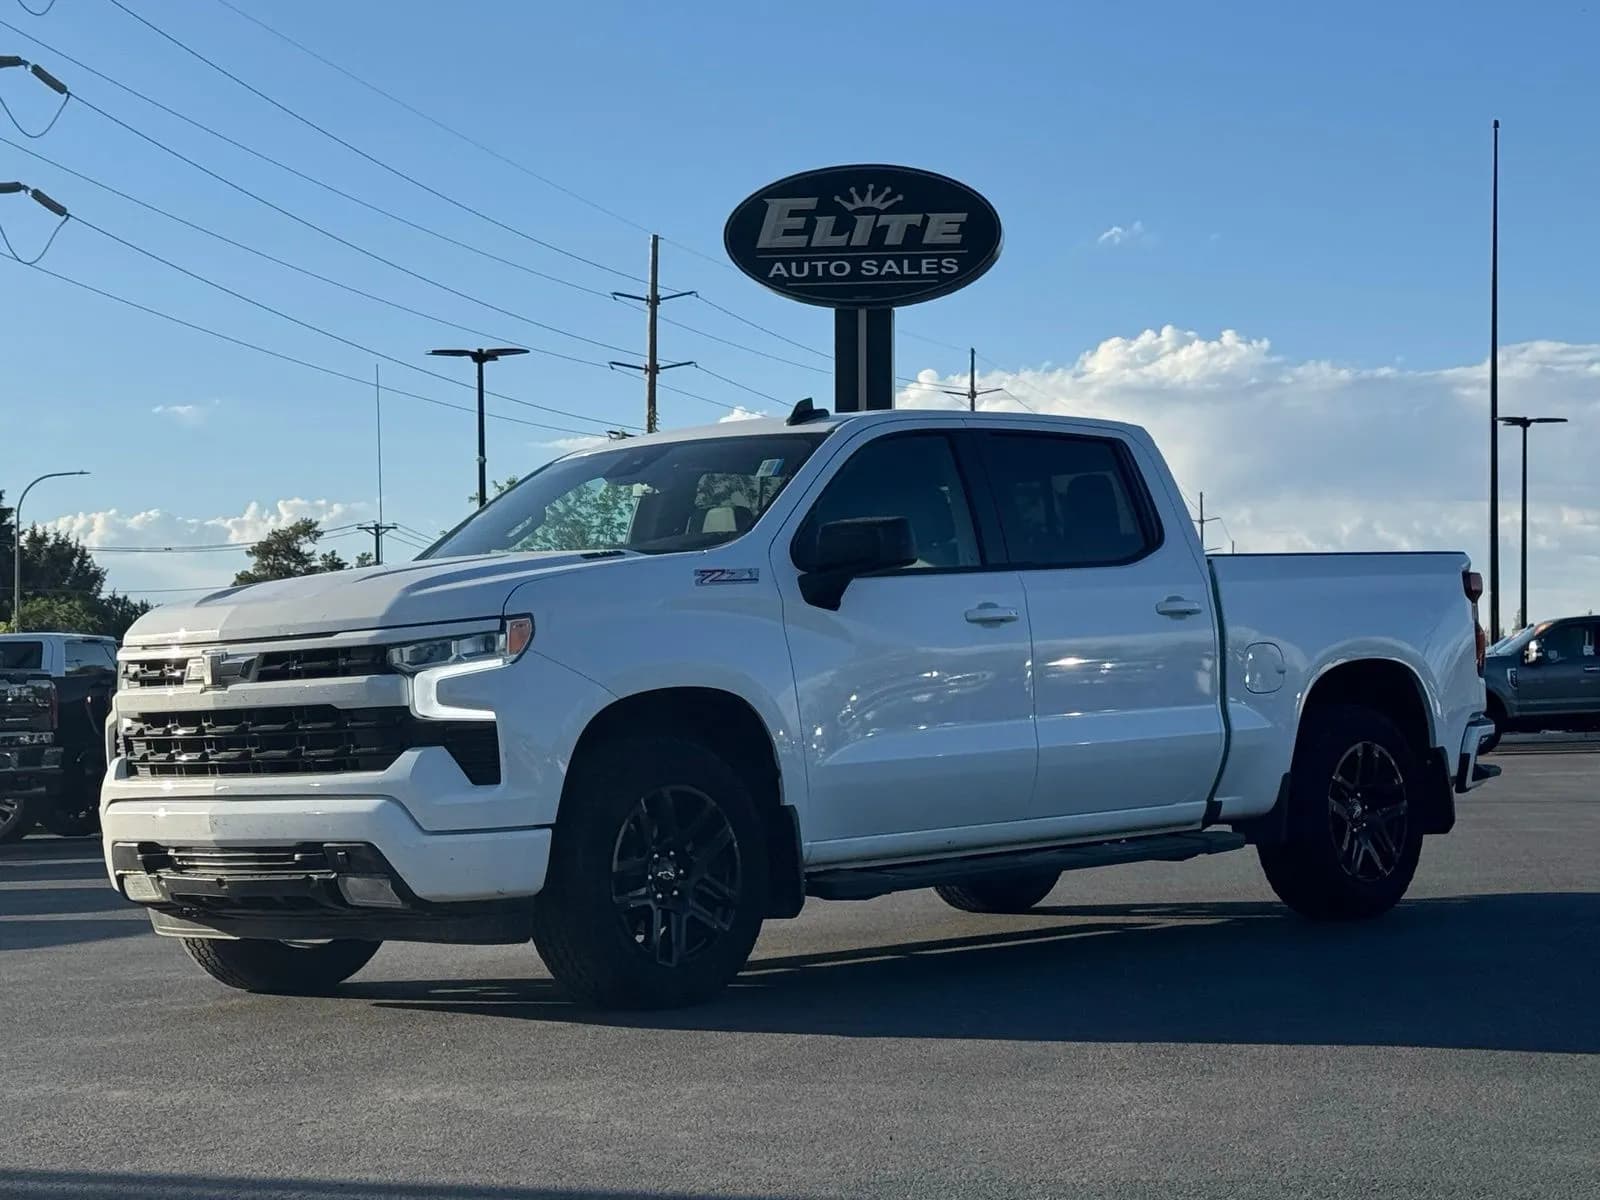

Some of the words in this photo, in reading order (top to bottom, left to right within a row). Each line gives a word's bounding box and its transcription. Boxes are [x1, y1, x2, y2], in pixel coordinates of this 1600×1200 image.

[756, 197, 968, 249] ELITE
[768, 260, 851, 278] AUTO
[860, 258, 959, 276] SALES
